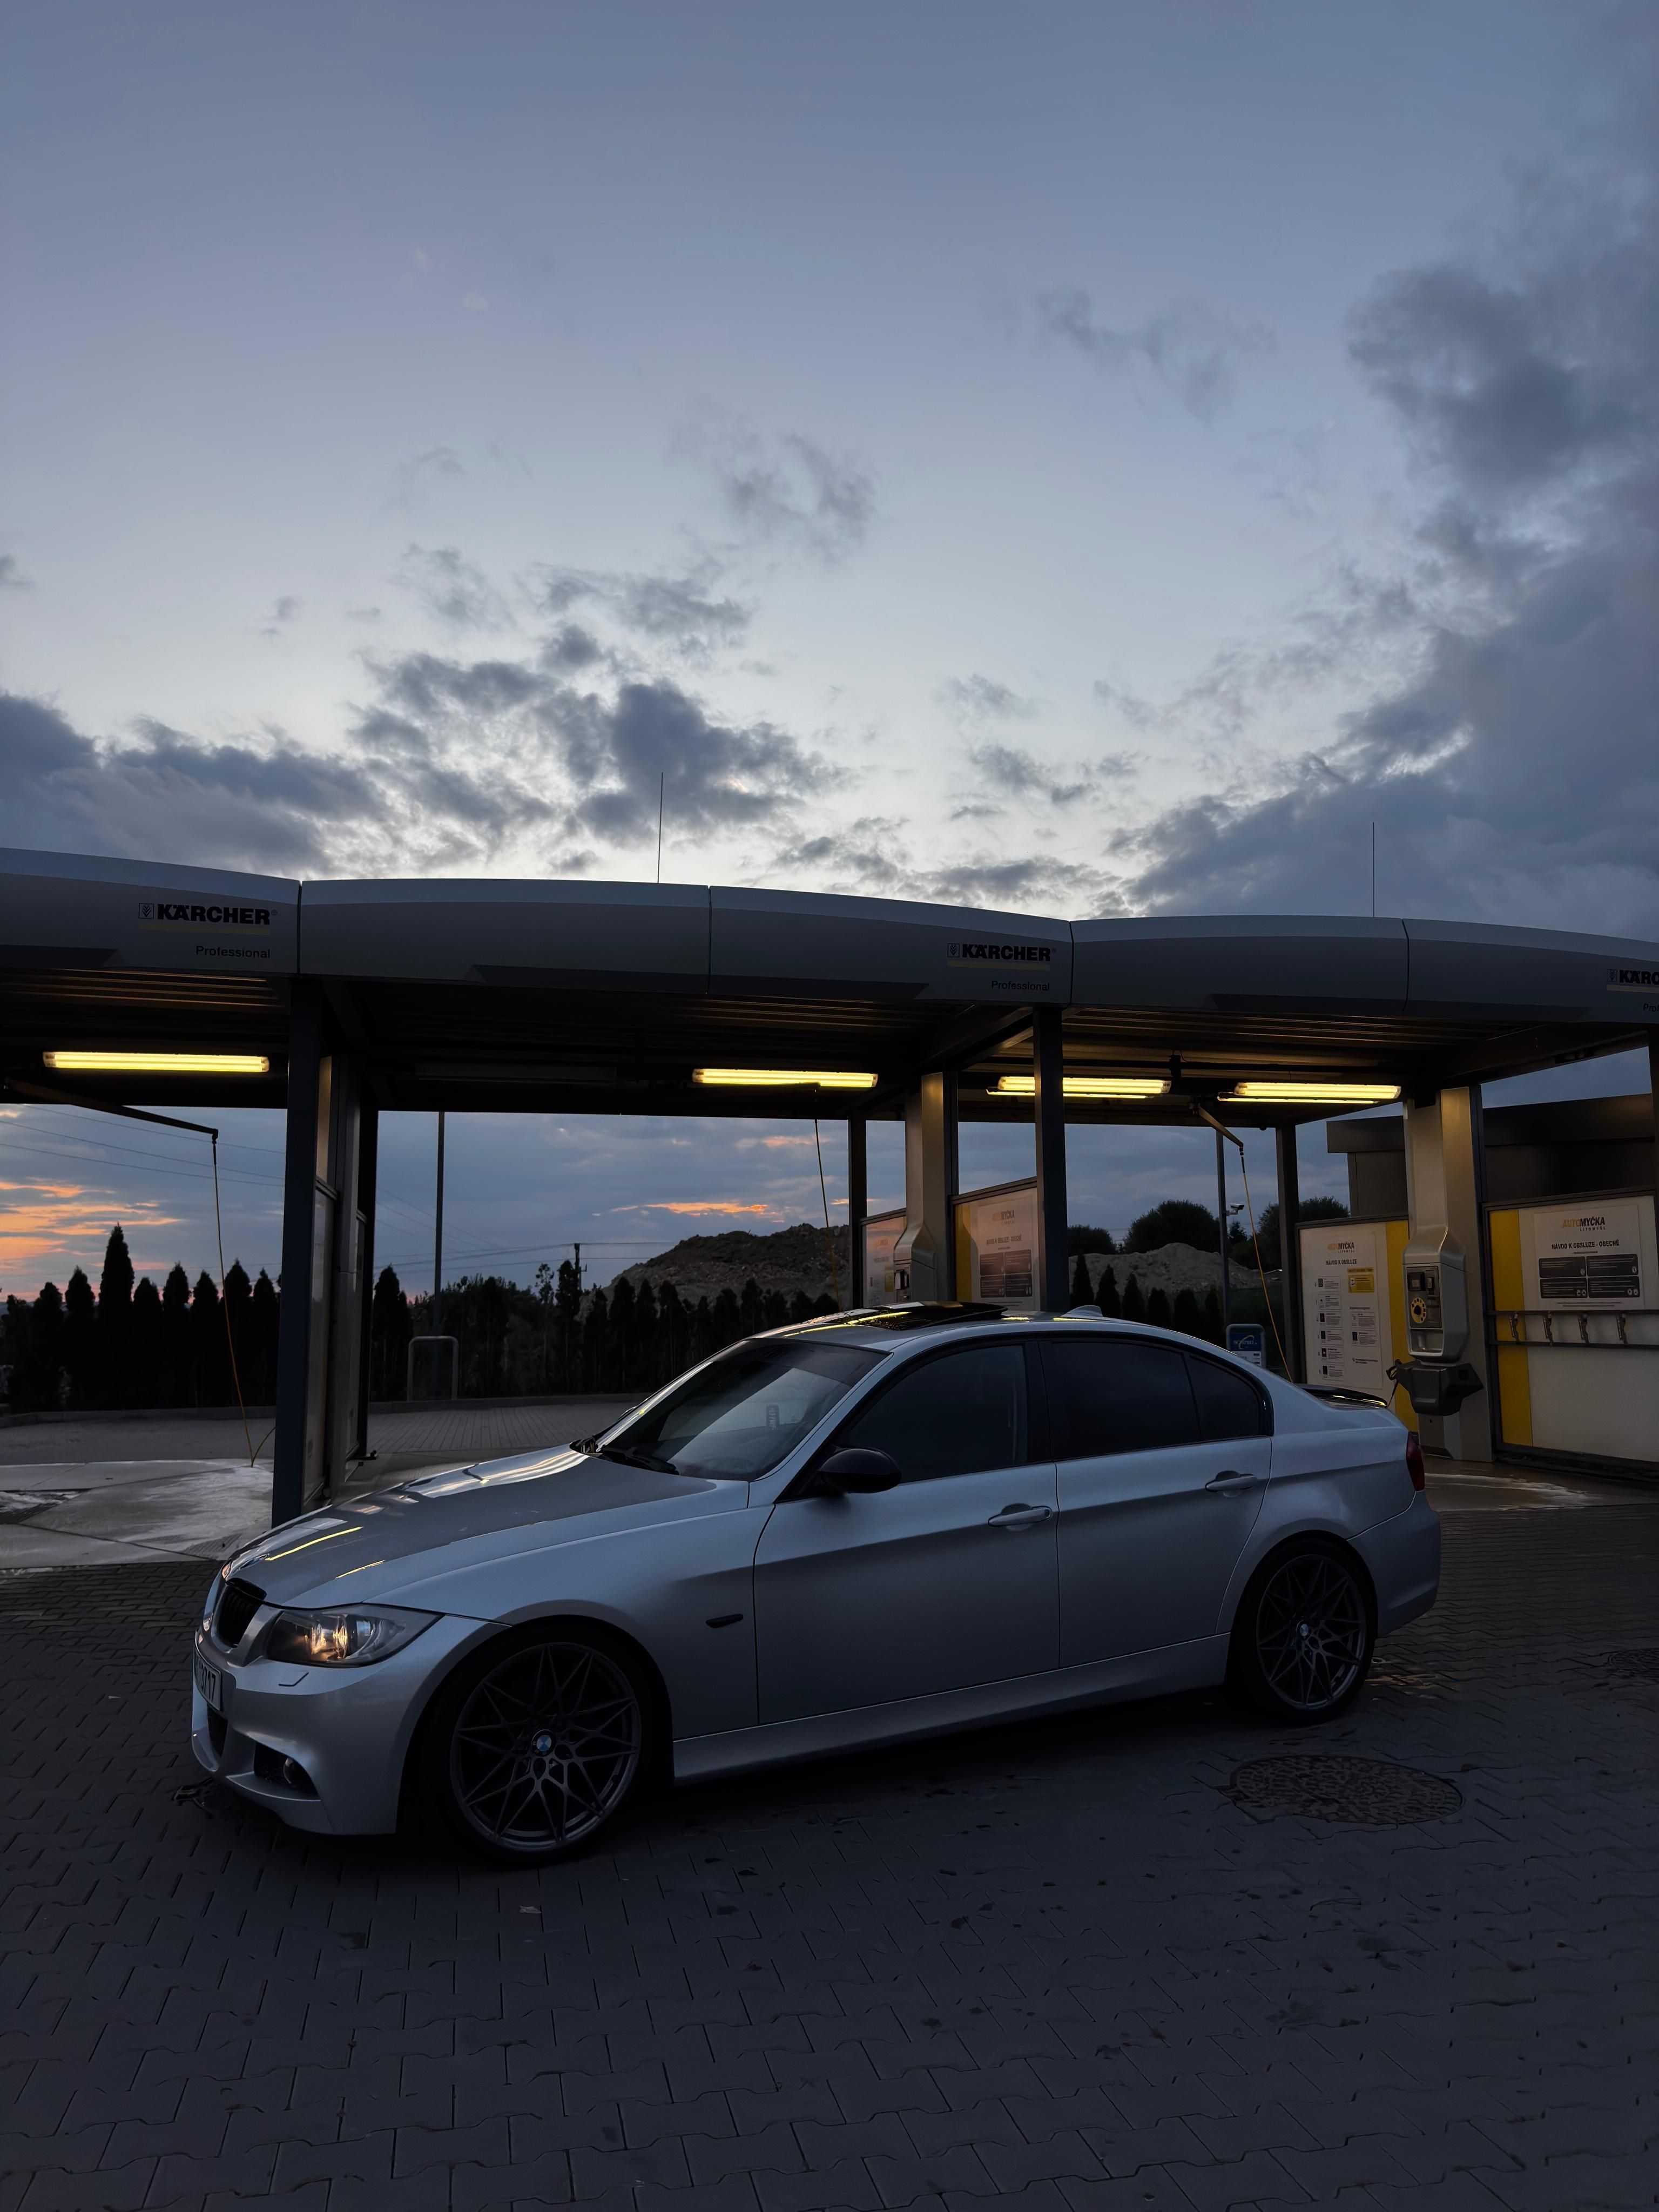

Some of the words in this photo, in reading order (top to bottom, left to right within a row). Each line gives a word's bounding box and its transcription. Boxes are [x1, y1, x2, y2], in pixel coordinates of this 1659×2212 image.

[158, 903, 270, 925] KÄRCHER
[196, 946, 271, 959] Professional
[962, 943, 1050, 961] KÄRCHER
[992, 980, 1050, 991] Professional
